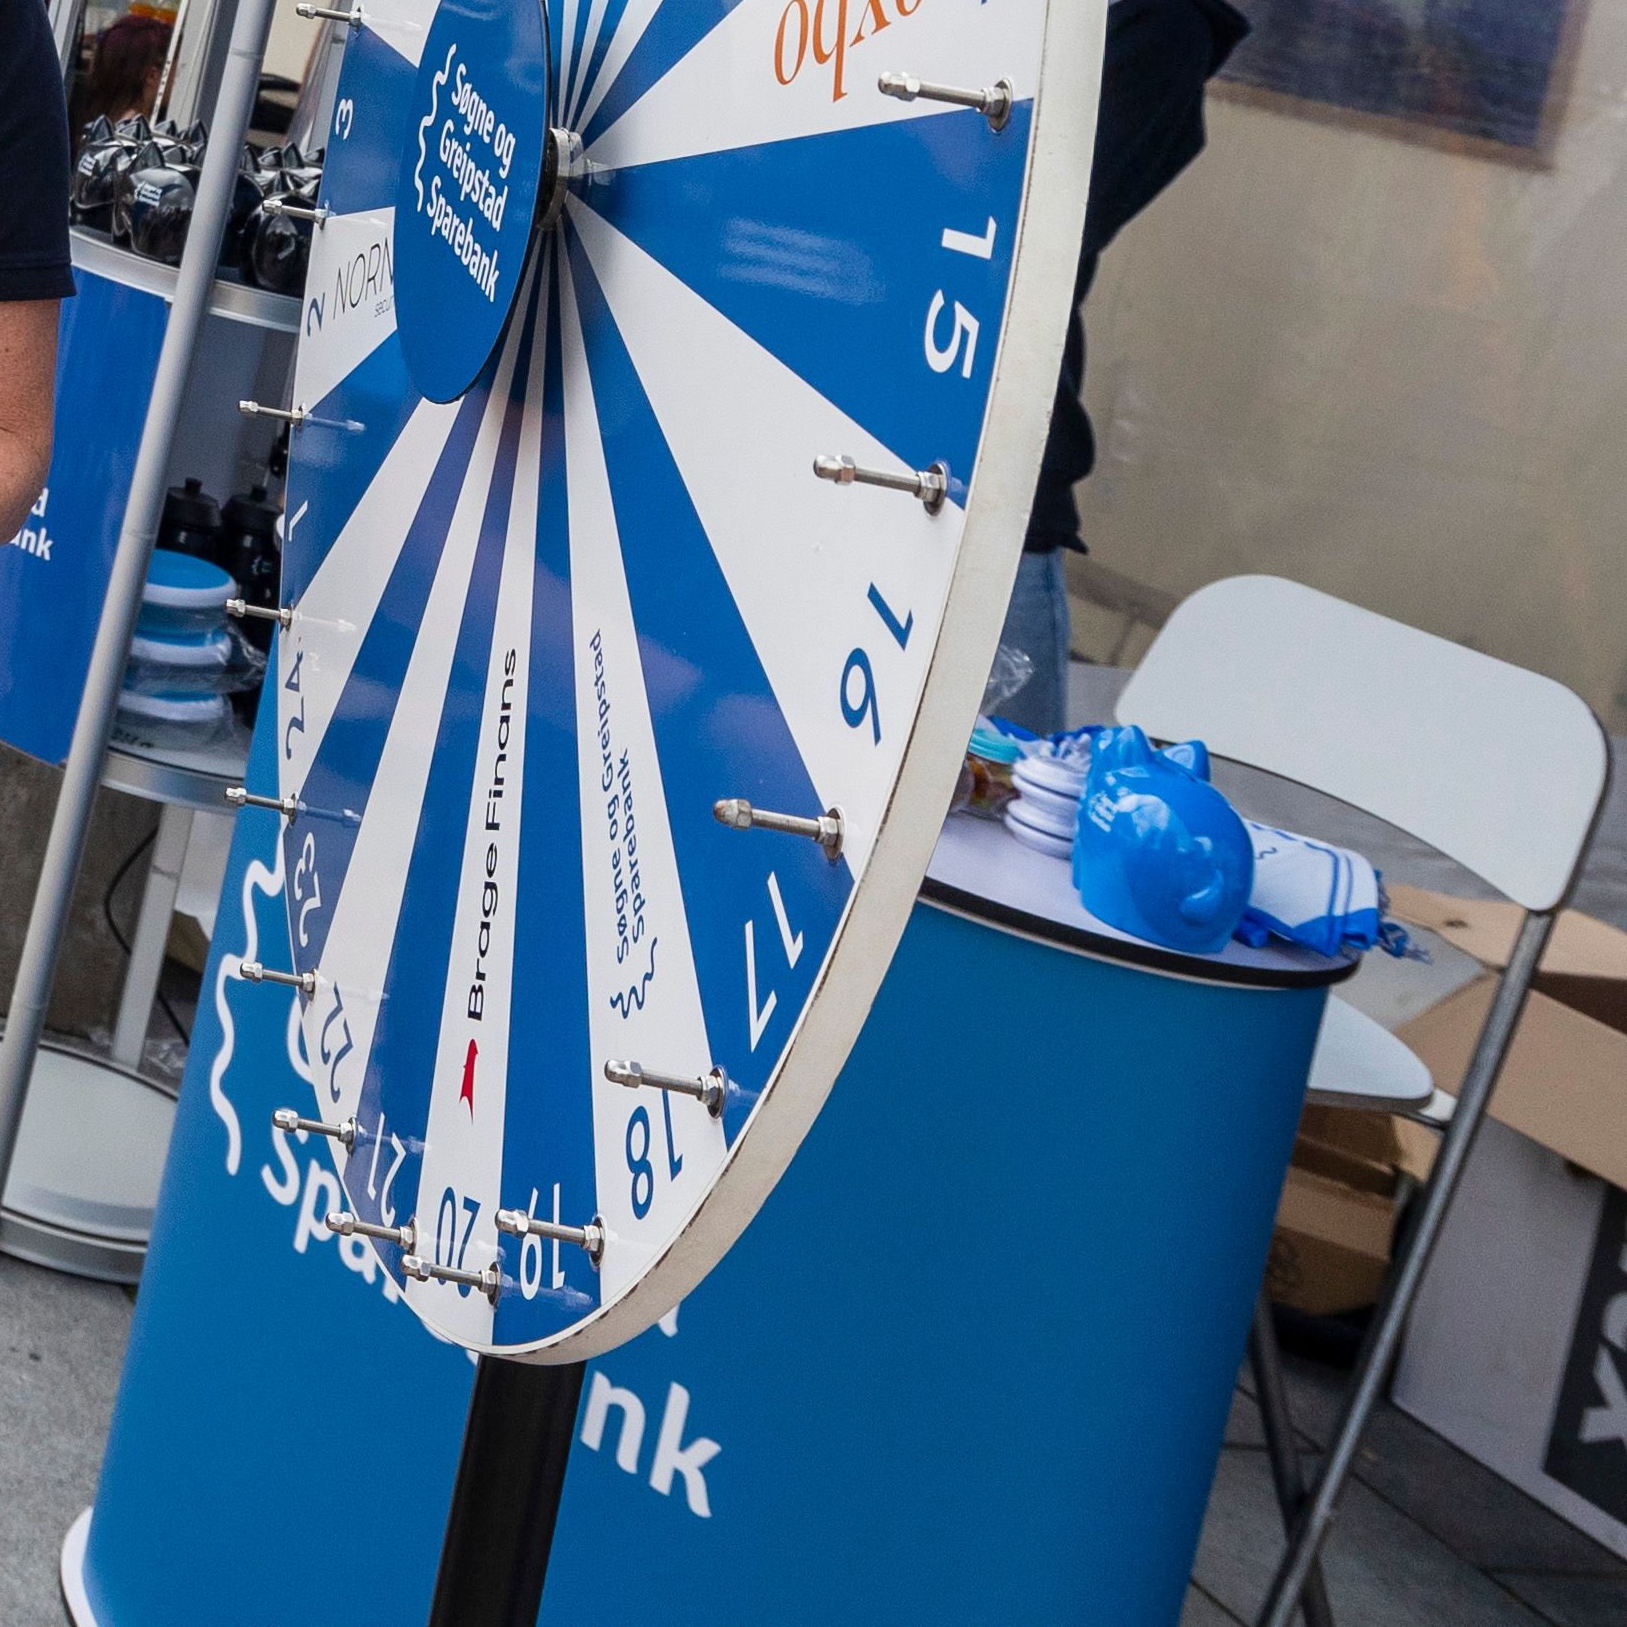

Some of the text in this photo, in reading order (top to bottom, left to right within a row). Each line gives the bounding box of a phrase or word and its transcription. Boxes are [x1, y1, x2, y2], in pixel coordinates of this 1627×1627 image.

[335, 98, 354, 140] 3
[439, 119, 508, 232] Greipstad
[451, 63, 516, 179] Søgne og
[333, 237, 395, 320] NORN
[427, 175, 500, 303] Sparebank
[306, 292, 326, 337] 2
[924, 216, 997, 379] 15
[288, 500, 308, 542] 1
[285, 648, 305, 761] 24
[840, 582, 914, 747] 16
[467, 648, 516, 1022] Brage Finans
[589, 628, 629, 964] Søgne og Greipstad
[616, 748, 645, 944] Sparebank
[294, 831, 322, 947] 23
[744, 871, 804, 1054] 17
[321, 981, 353, 1103] 22
[366, 1112, 408, 1228] 21
[626, 1088, 683, 1220] 18
[435, 1187, 481, 1298] 20
[520, 1183, 565, 1300] 19
